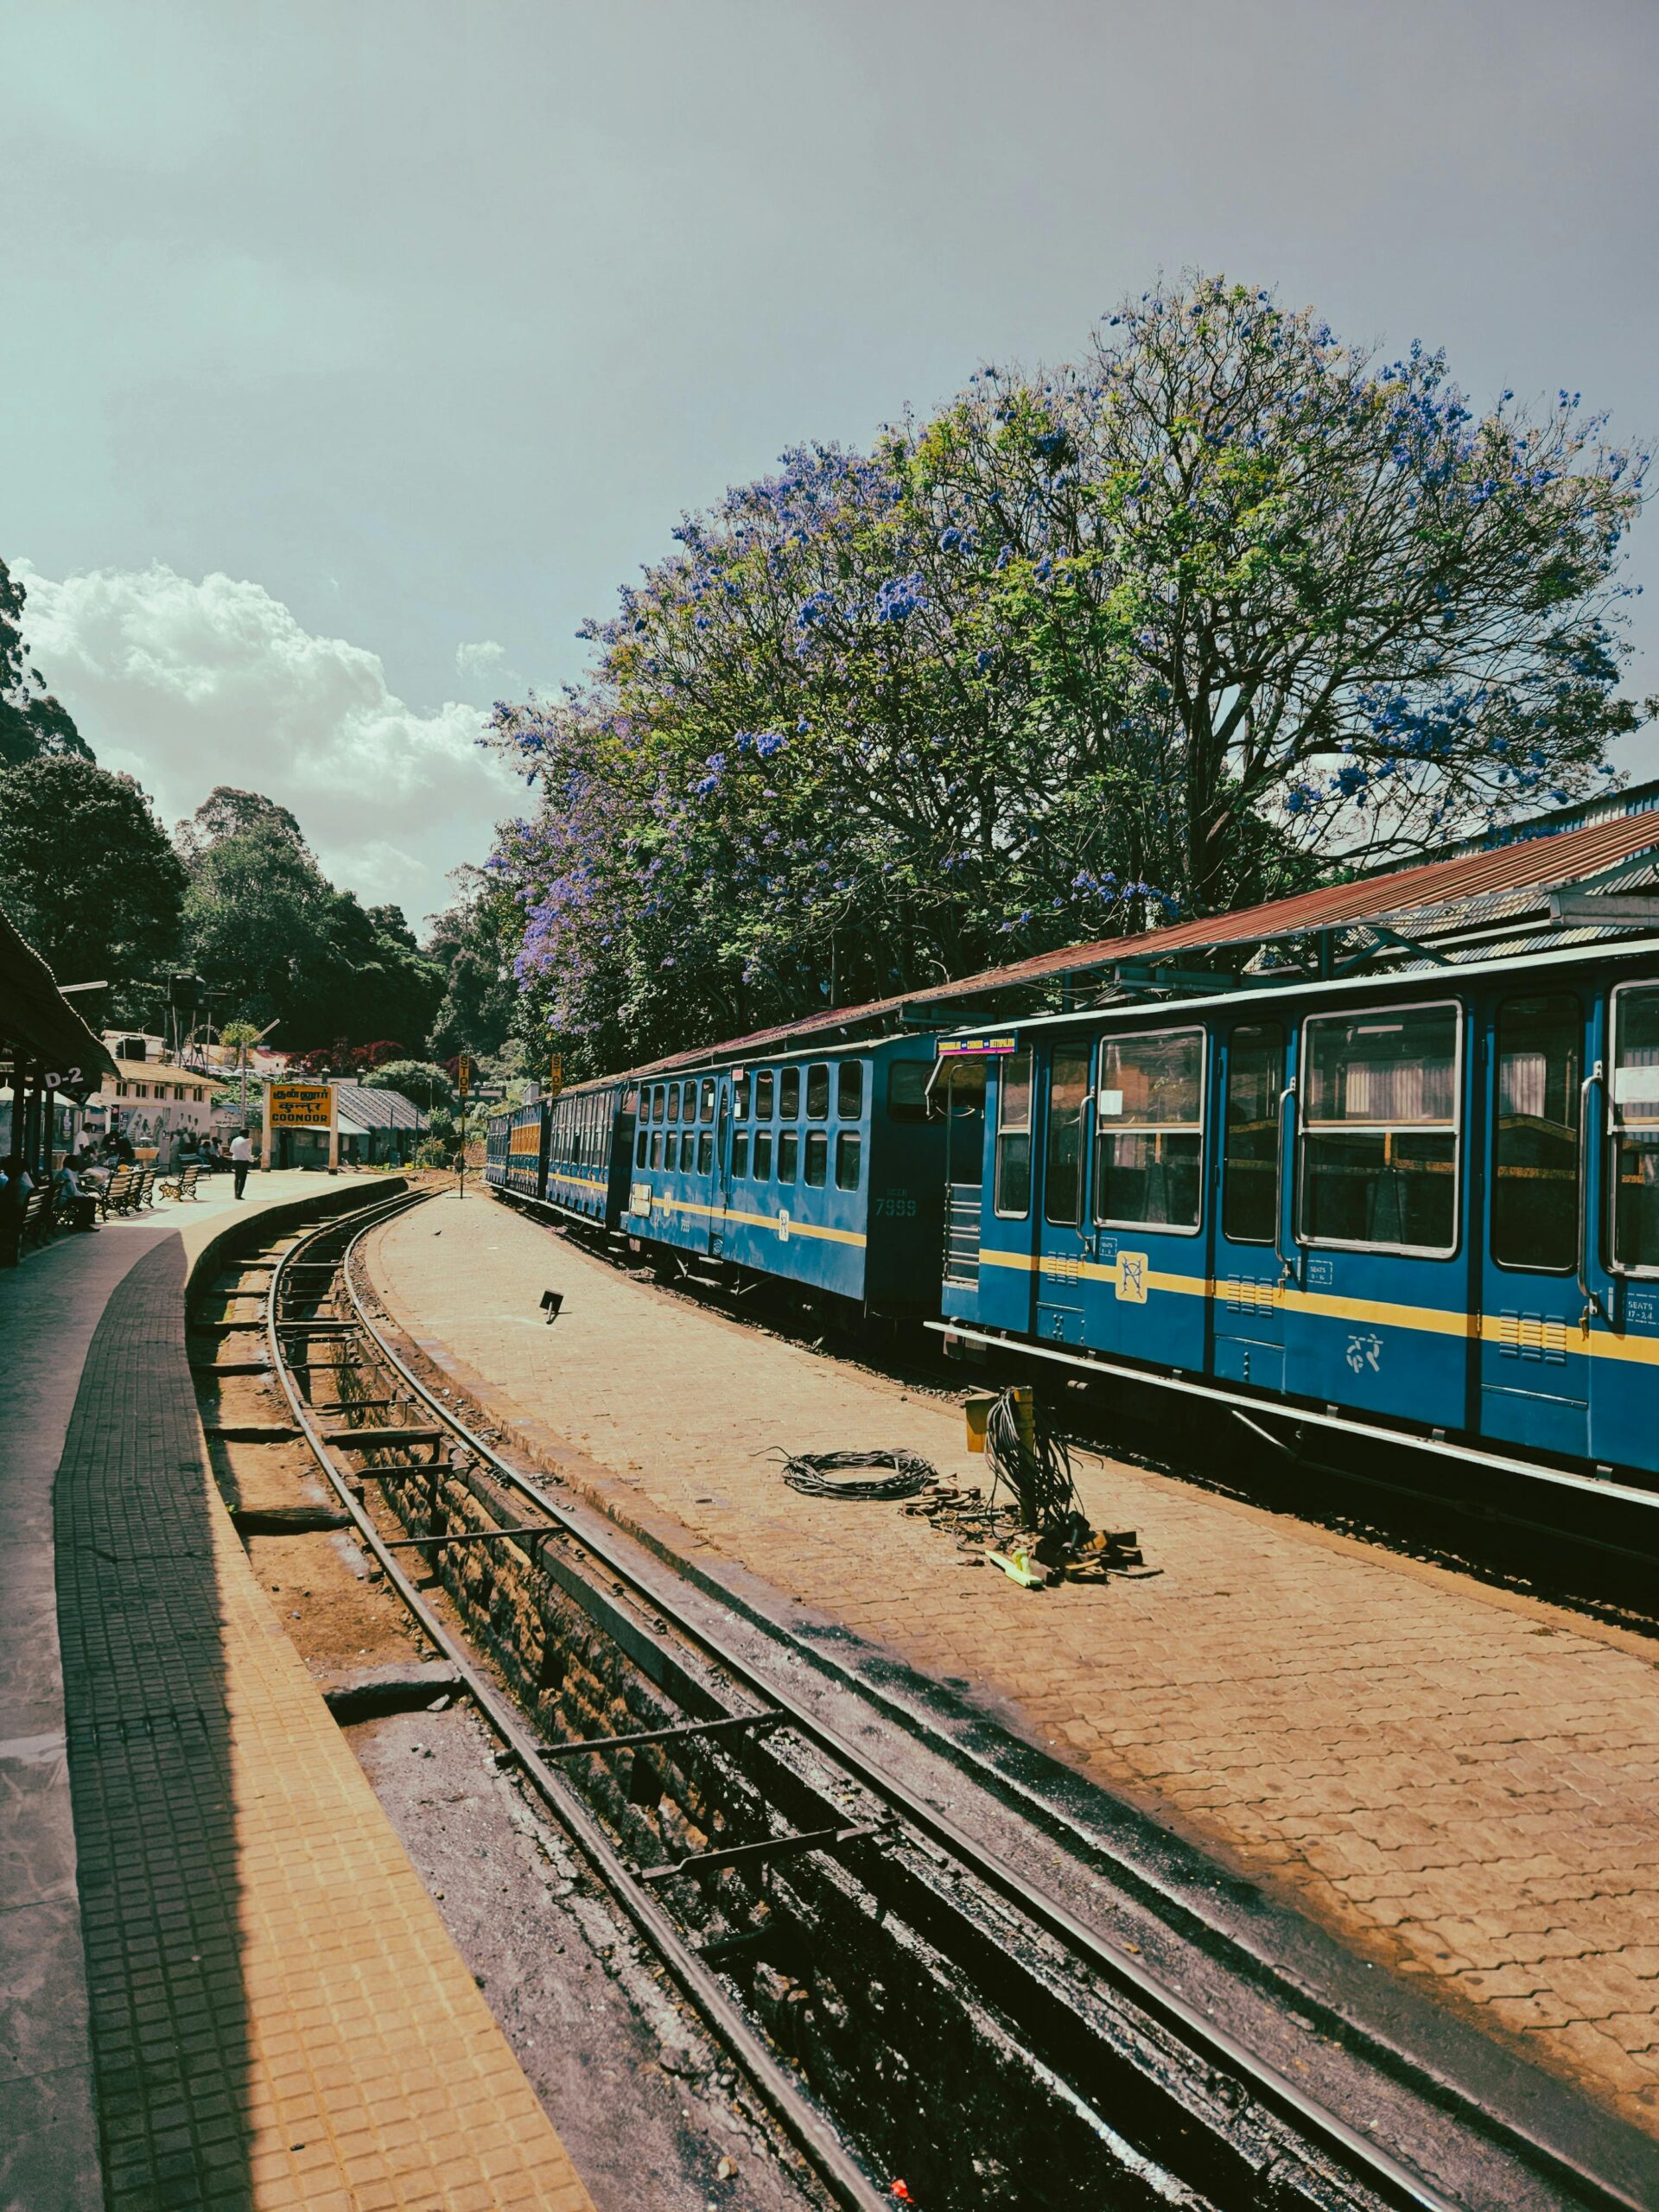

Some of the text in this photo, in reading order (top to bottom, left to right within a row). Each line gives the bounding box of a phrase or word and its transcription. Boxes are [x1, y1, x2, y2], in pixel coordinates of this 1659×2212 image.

[44, 1067, 84, 1088] D-2
[460, 1056, 468, 1096] STOP
[272, 1113, 327, 1122] COONOOR
[1628, 1300, 1653, 1311] SEATS
